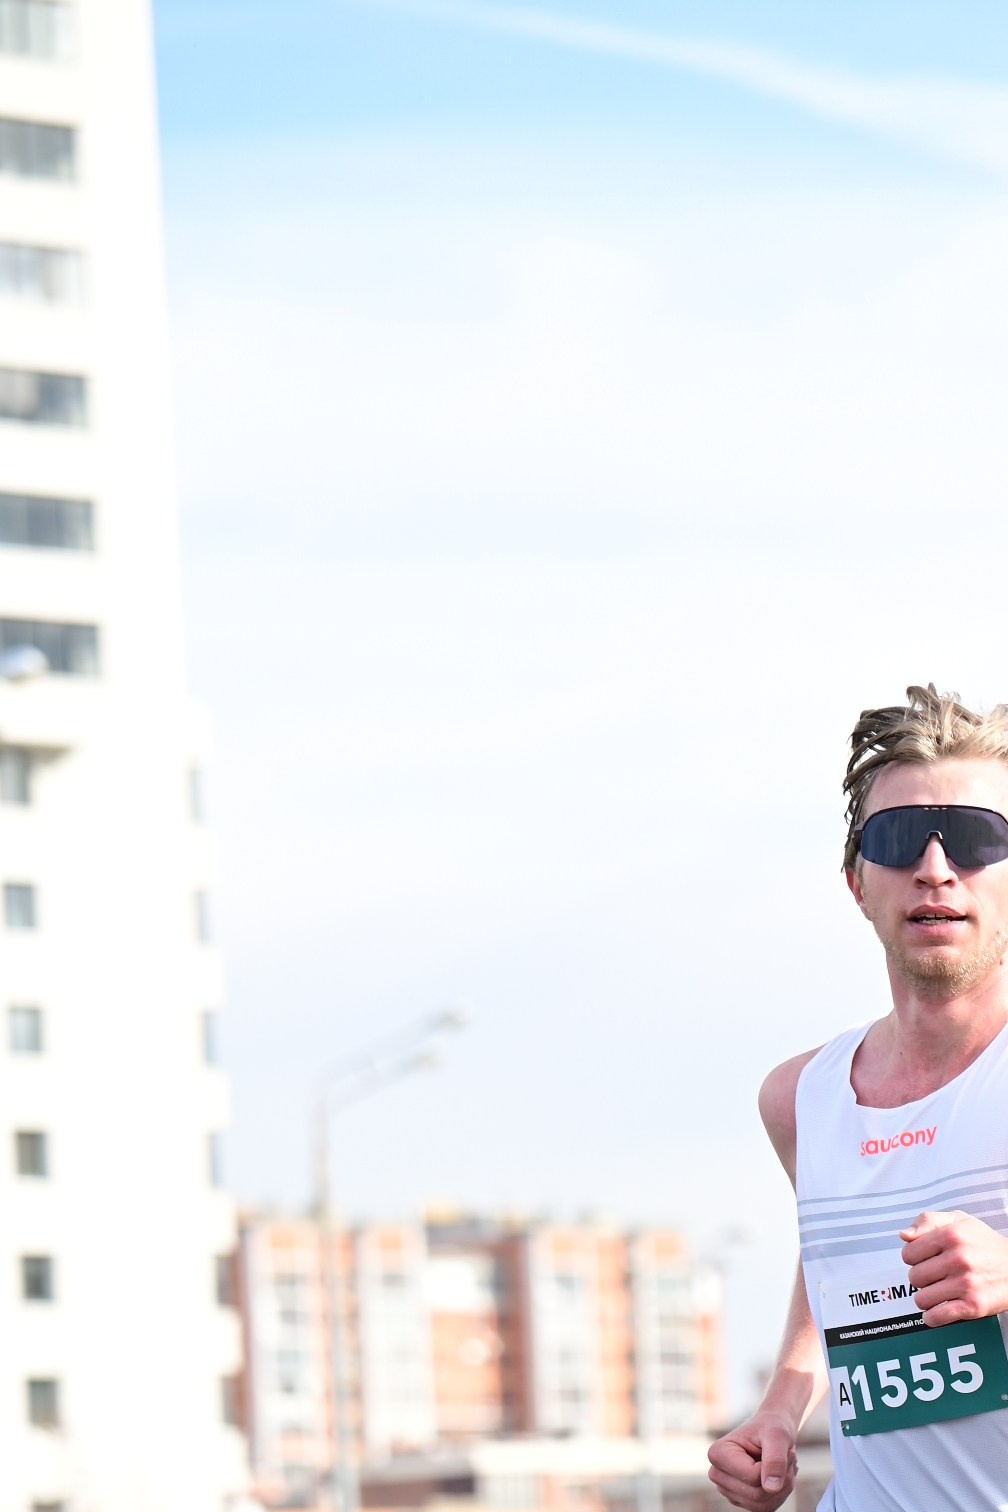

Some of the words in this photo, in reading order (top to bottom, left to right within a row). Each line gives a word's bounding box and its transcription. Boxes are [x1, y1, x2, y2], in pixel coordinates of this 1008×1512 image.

[860, 1126, 937, 1157] saucony
[865, 1319, 915, 1336] НАЦИОНАЛЬНЫЙ
[914, 1318, 926, 1327] ПО
